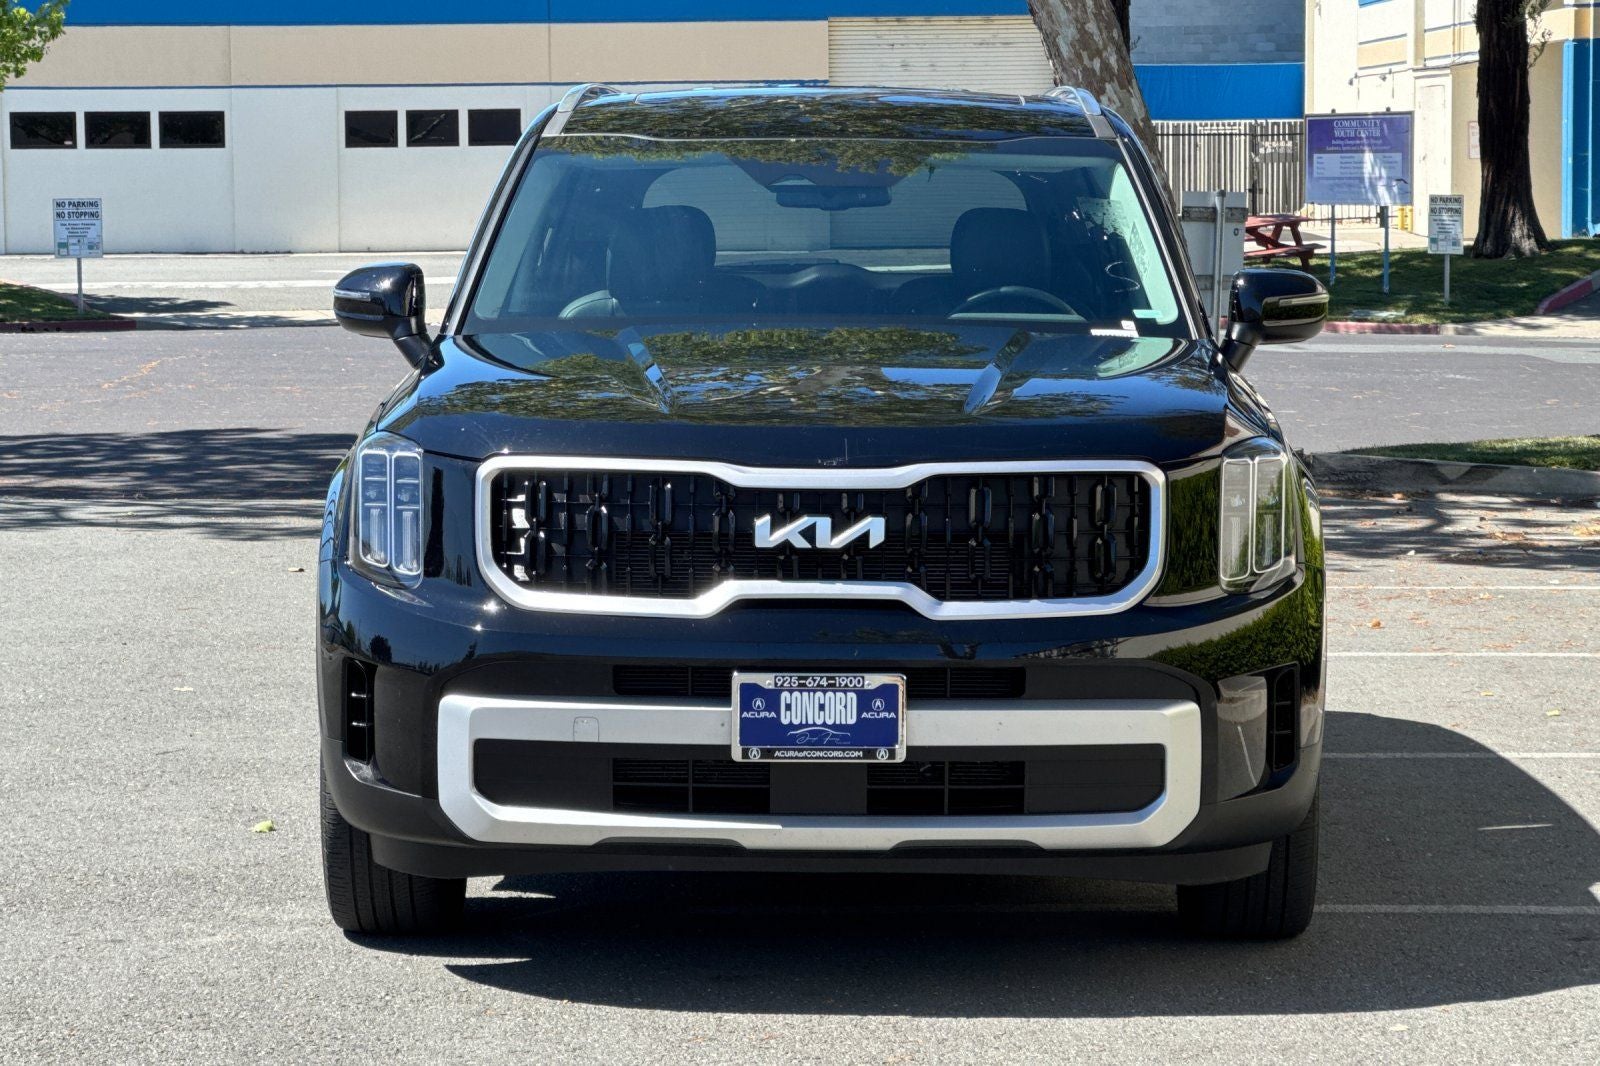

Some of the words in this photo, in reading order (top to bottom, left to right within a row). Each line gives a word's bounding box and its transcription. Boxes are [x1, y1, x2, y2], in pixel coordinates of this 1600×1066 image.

[1333, 119, 1381, 128] COMMUNITY
[1334, 129, 1355, 138] YOUTH
[1356, 129, 1381, 137] CENTER
[67, 200, 99, 208] PARKING
[1439, 196, 1462, 204] PARKING
[55, 211, 66, 219] NO
[67, 210, 100, 219] STOPPING
[775, 676, 864, 688] 925-674-1900
[780, 690, 858, 725] CONCORD
[741, 711, 777, 719] ACURA
[861, 711, 897, 719] ACURA
[774, 750, 863, 758] ACURAofCONCORD.COM
